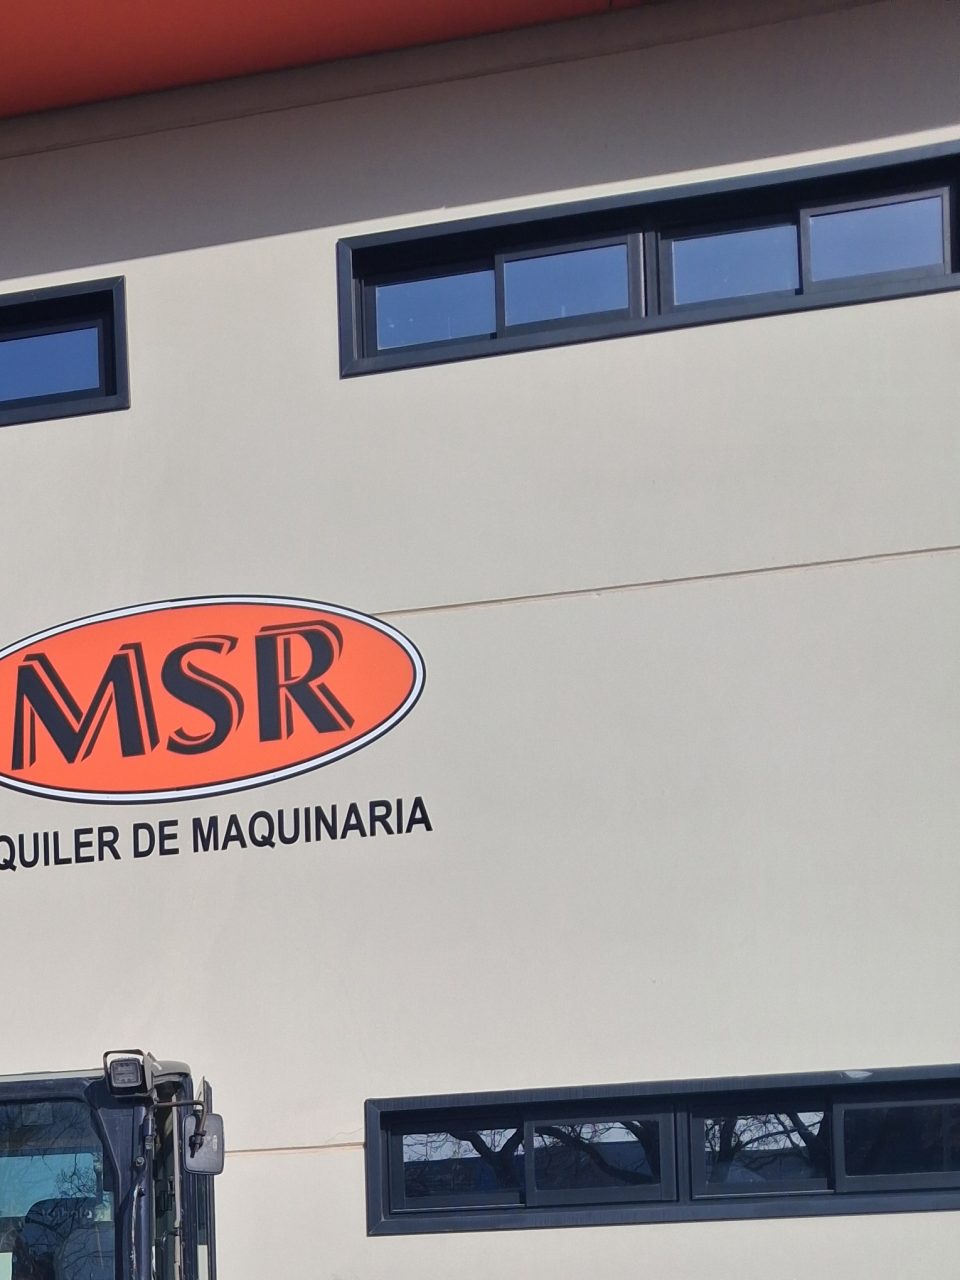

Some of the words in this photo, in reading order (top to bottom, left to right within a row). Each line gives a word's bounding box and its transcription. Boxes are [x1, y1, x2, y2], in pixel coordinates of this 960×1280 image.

[11, 619, 355, 771] MSR
[132, 819, 179, 858] DE
[192, 796, 433, 853] MAQUINARIA
